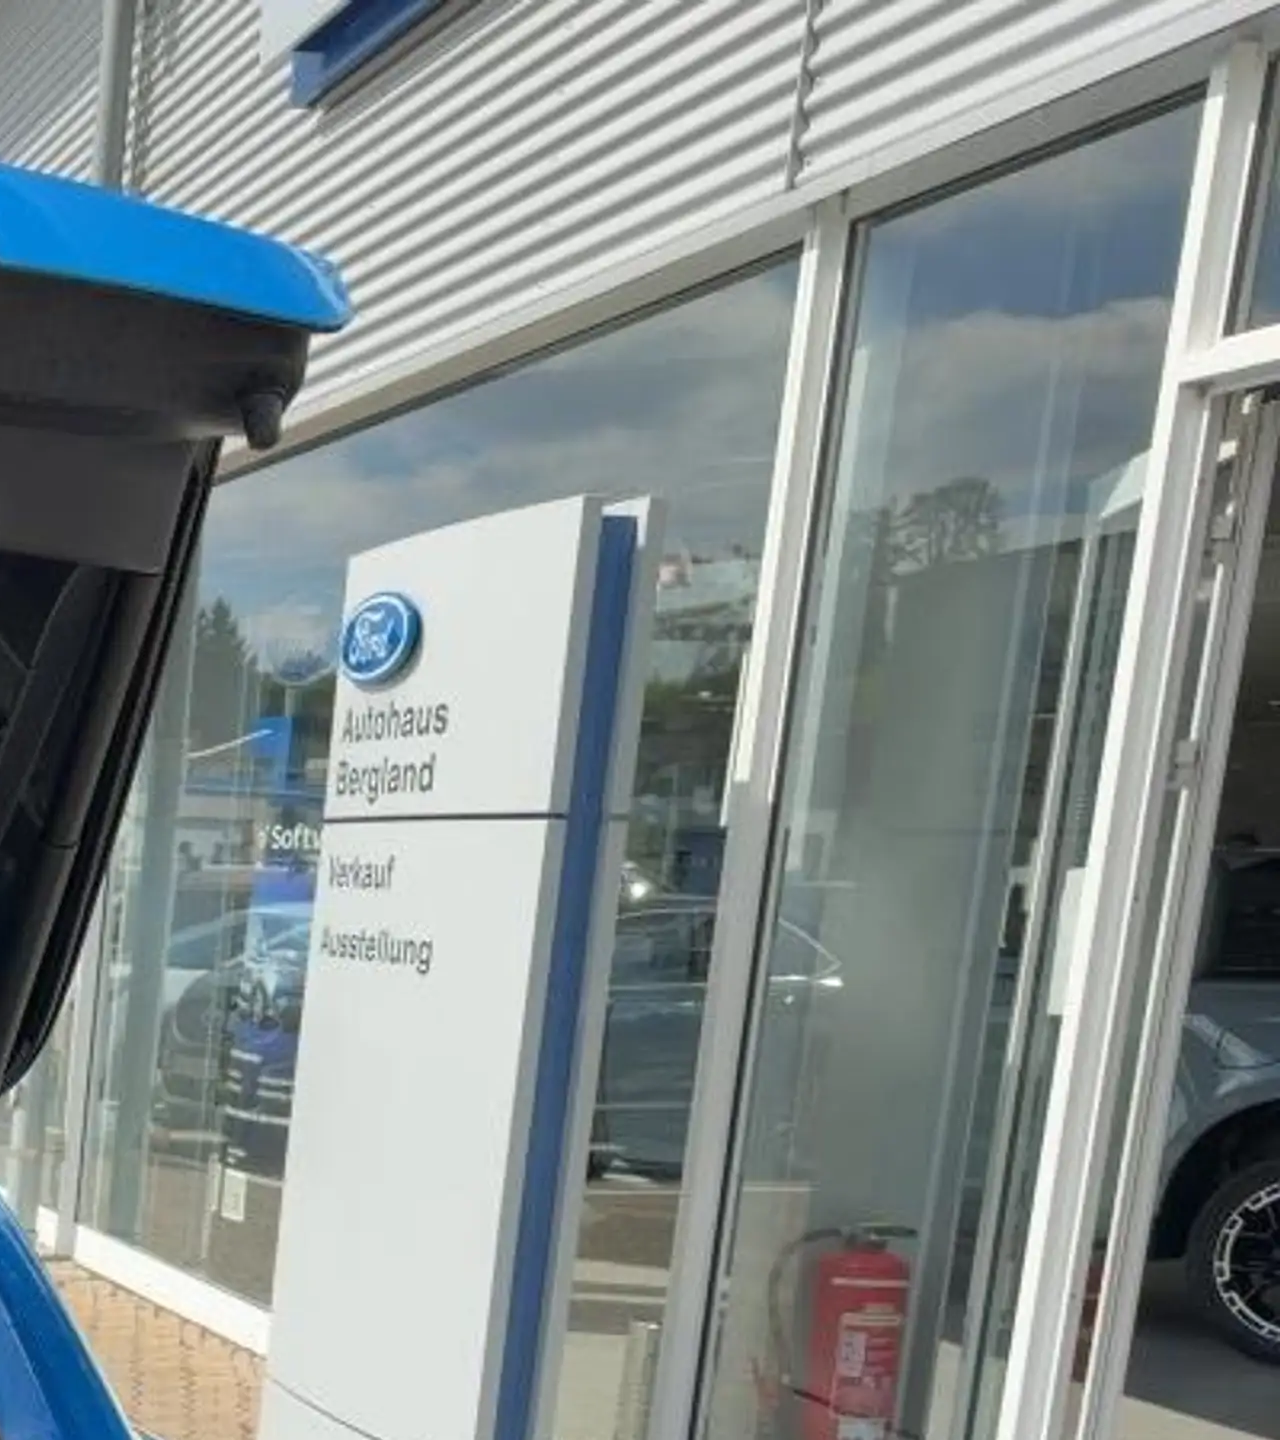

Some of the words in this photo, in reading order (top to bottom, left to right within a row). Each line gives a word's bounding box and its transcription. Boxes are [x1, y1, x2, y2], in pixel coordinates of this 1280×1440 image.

[342, 702, 450, 744] Autohaus
[336, 752, 437, 806] Bergland
[329, 854, 395, 889] Verkauf
[320, 926, 434, 975] Ausstellung
